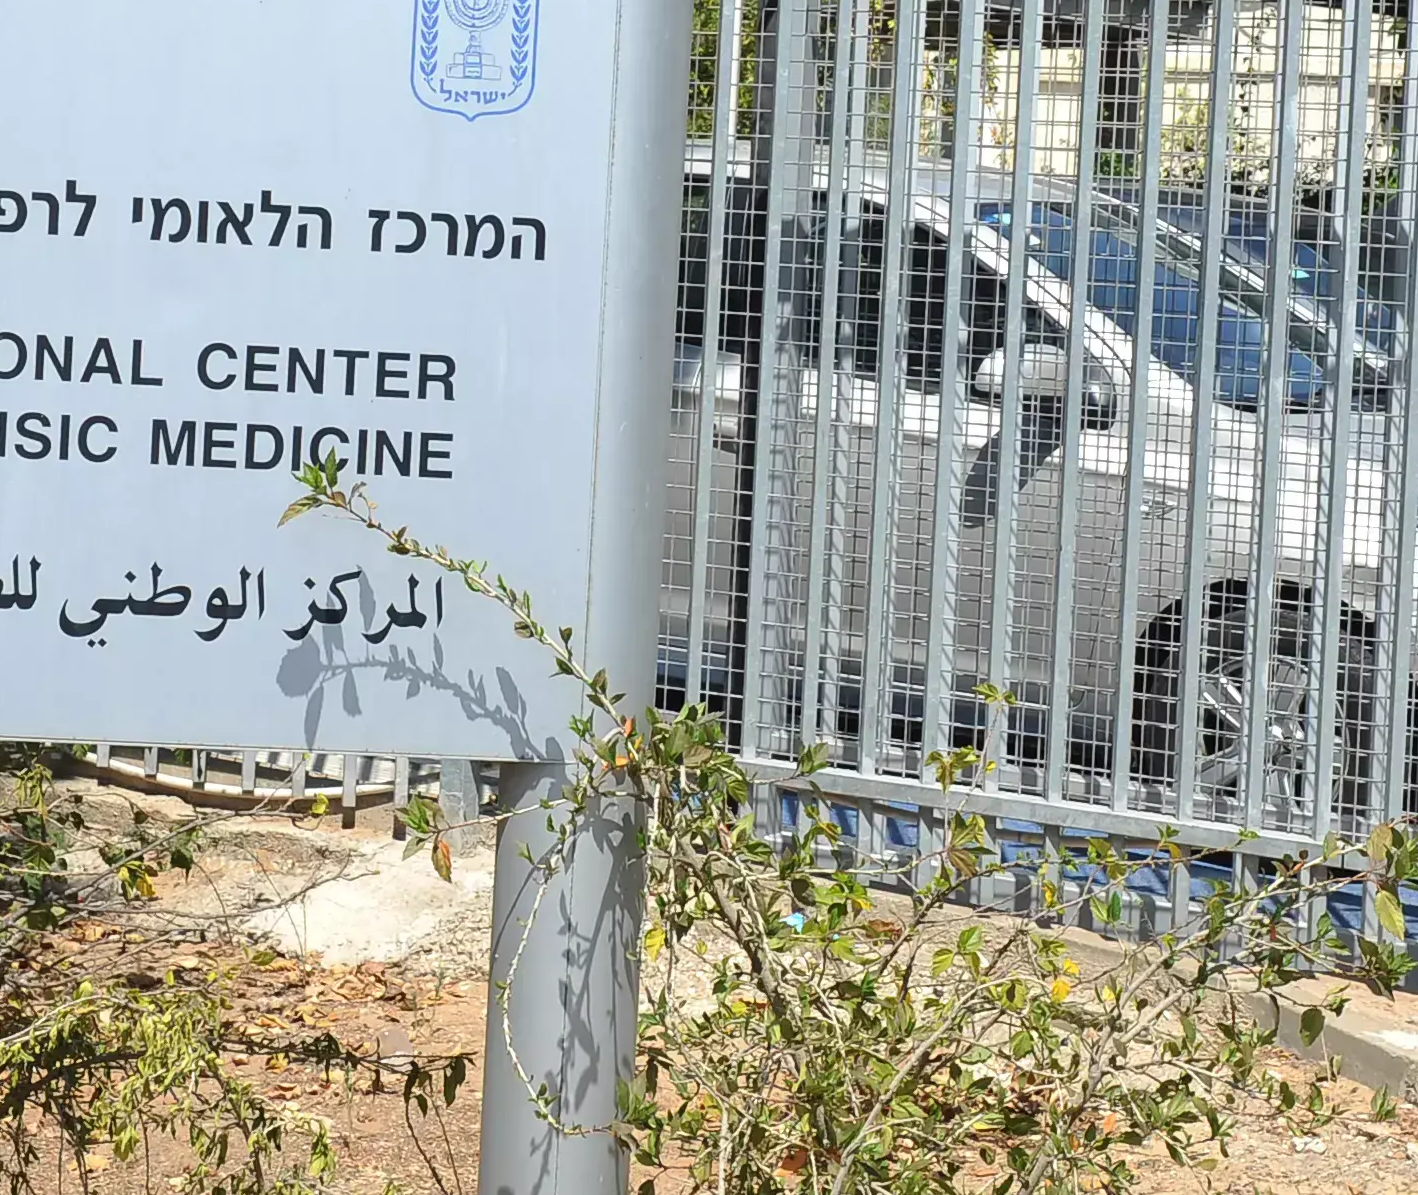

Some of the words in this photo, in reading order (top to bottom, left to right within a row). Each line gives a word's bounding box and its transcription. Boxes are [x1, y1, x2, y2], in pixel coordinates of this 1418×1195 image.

[439, 78, 507, 105] ישראל
[132, 190, 332, 250] הלאומי
[368, 209, 546, 261] המרכז
[197, 342, 456, 401] CENTER
[150, 419, 454, 478] MEDICINE
[58, 561, 265, 649] الوطني
[281, 570, 444, 645] المركز
